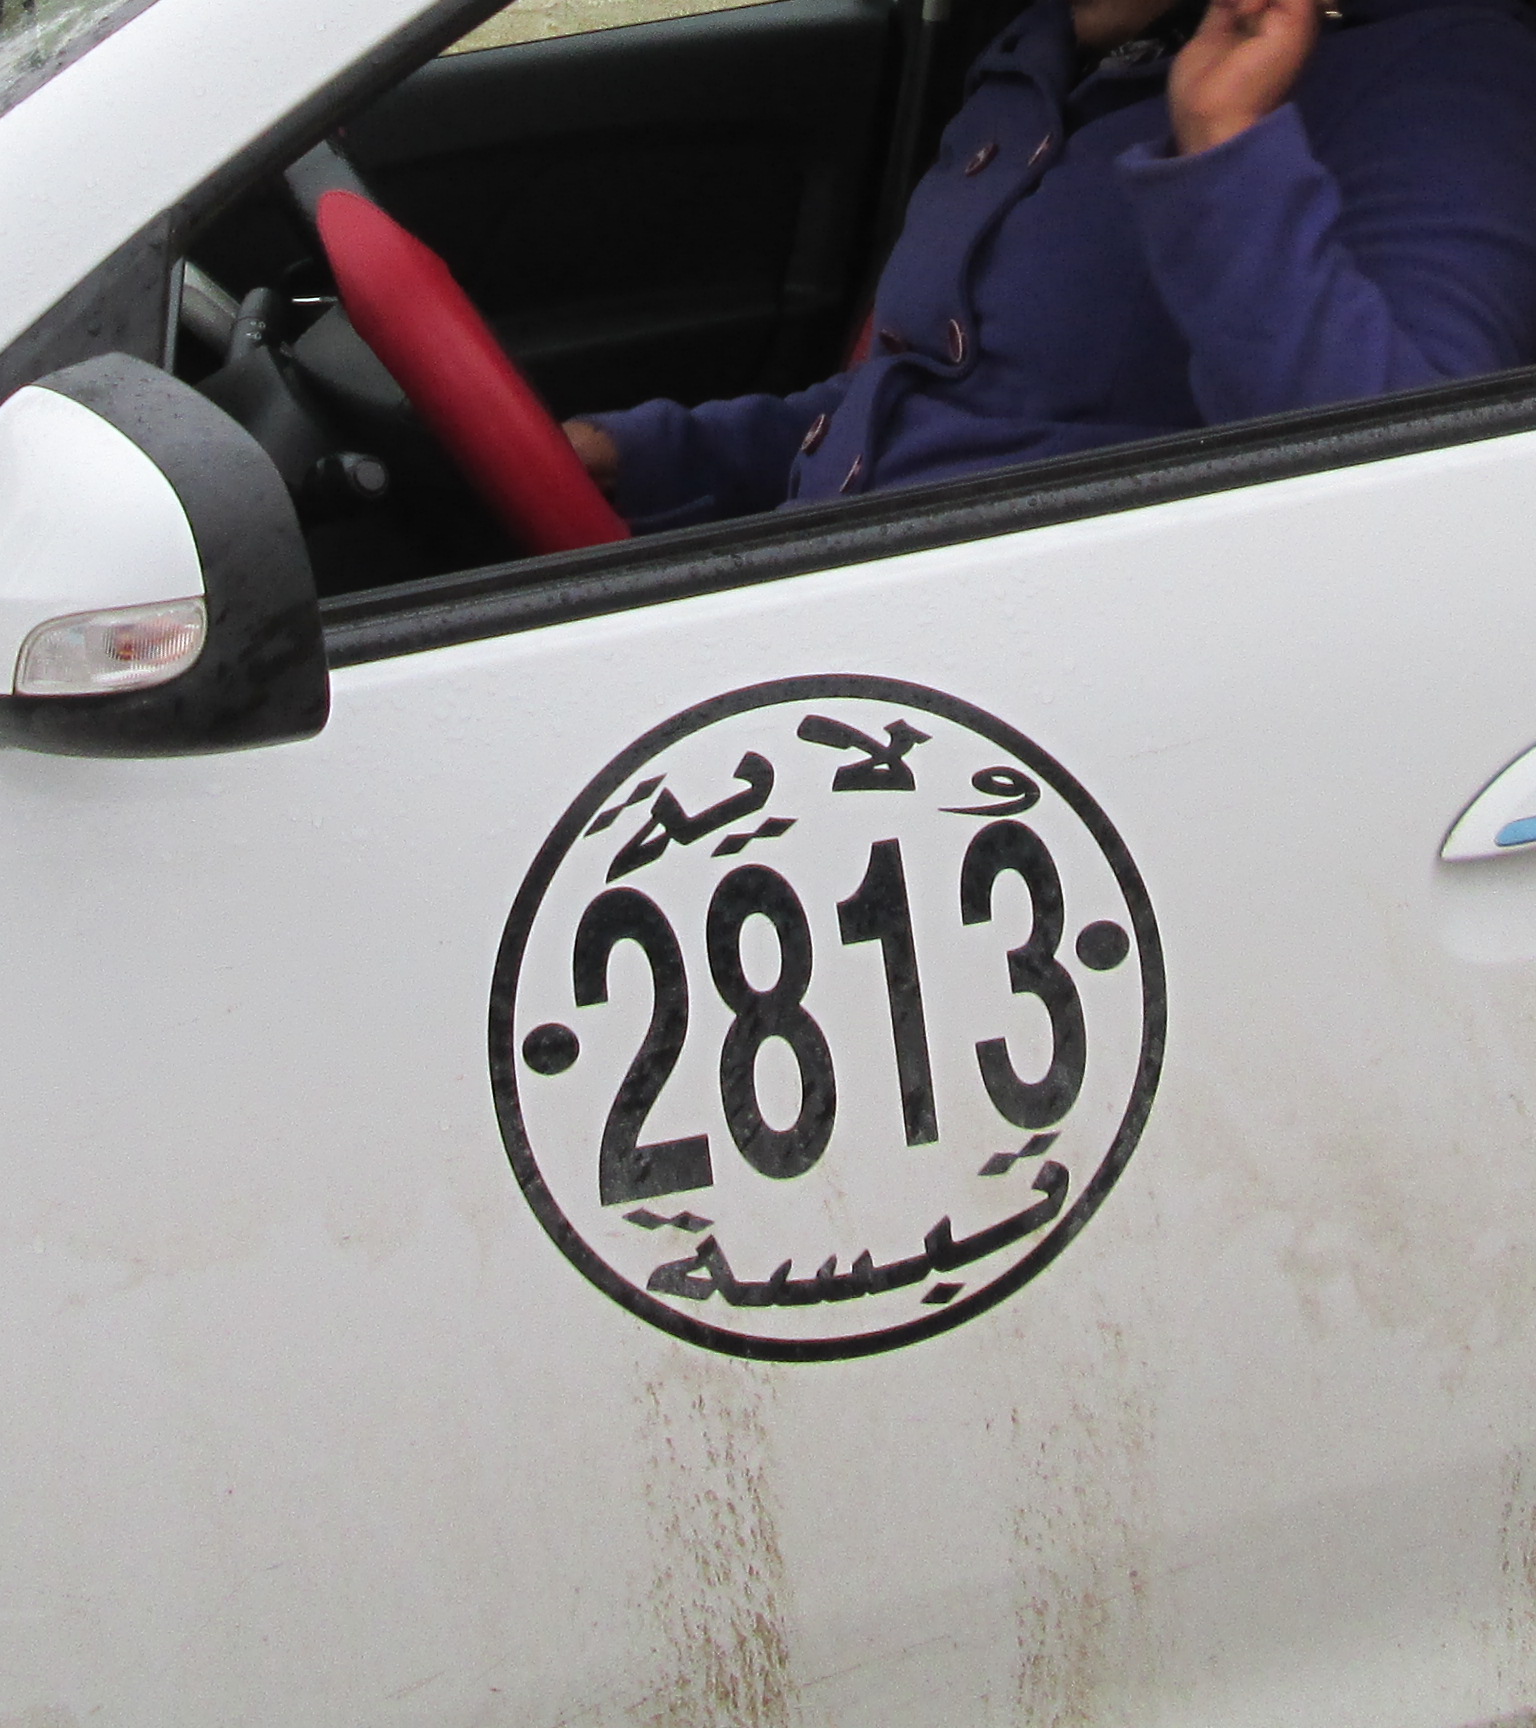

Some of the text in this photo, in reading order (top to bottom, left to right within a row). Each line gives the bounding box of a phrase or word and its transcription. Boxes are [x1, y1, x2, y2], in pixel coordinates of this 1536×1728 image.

[584, 714, 1041, 884] ولاية
[572, 818, 1088, 1208] 2813
[621, 1130, 1071, 1308] تبسة
